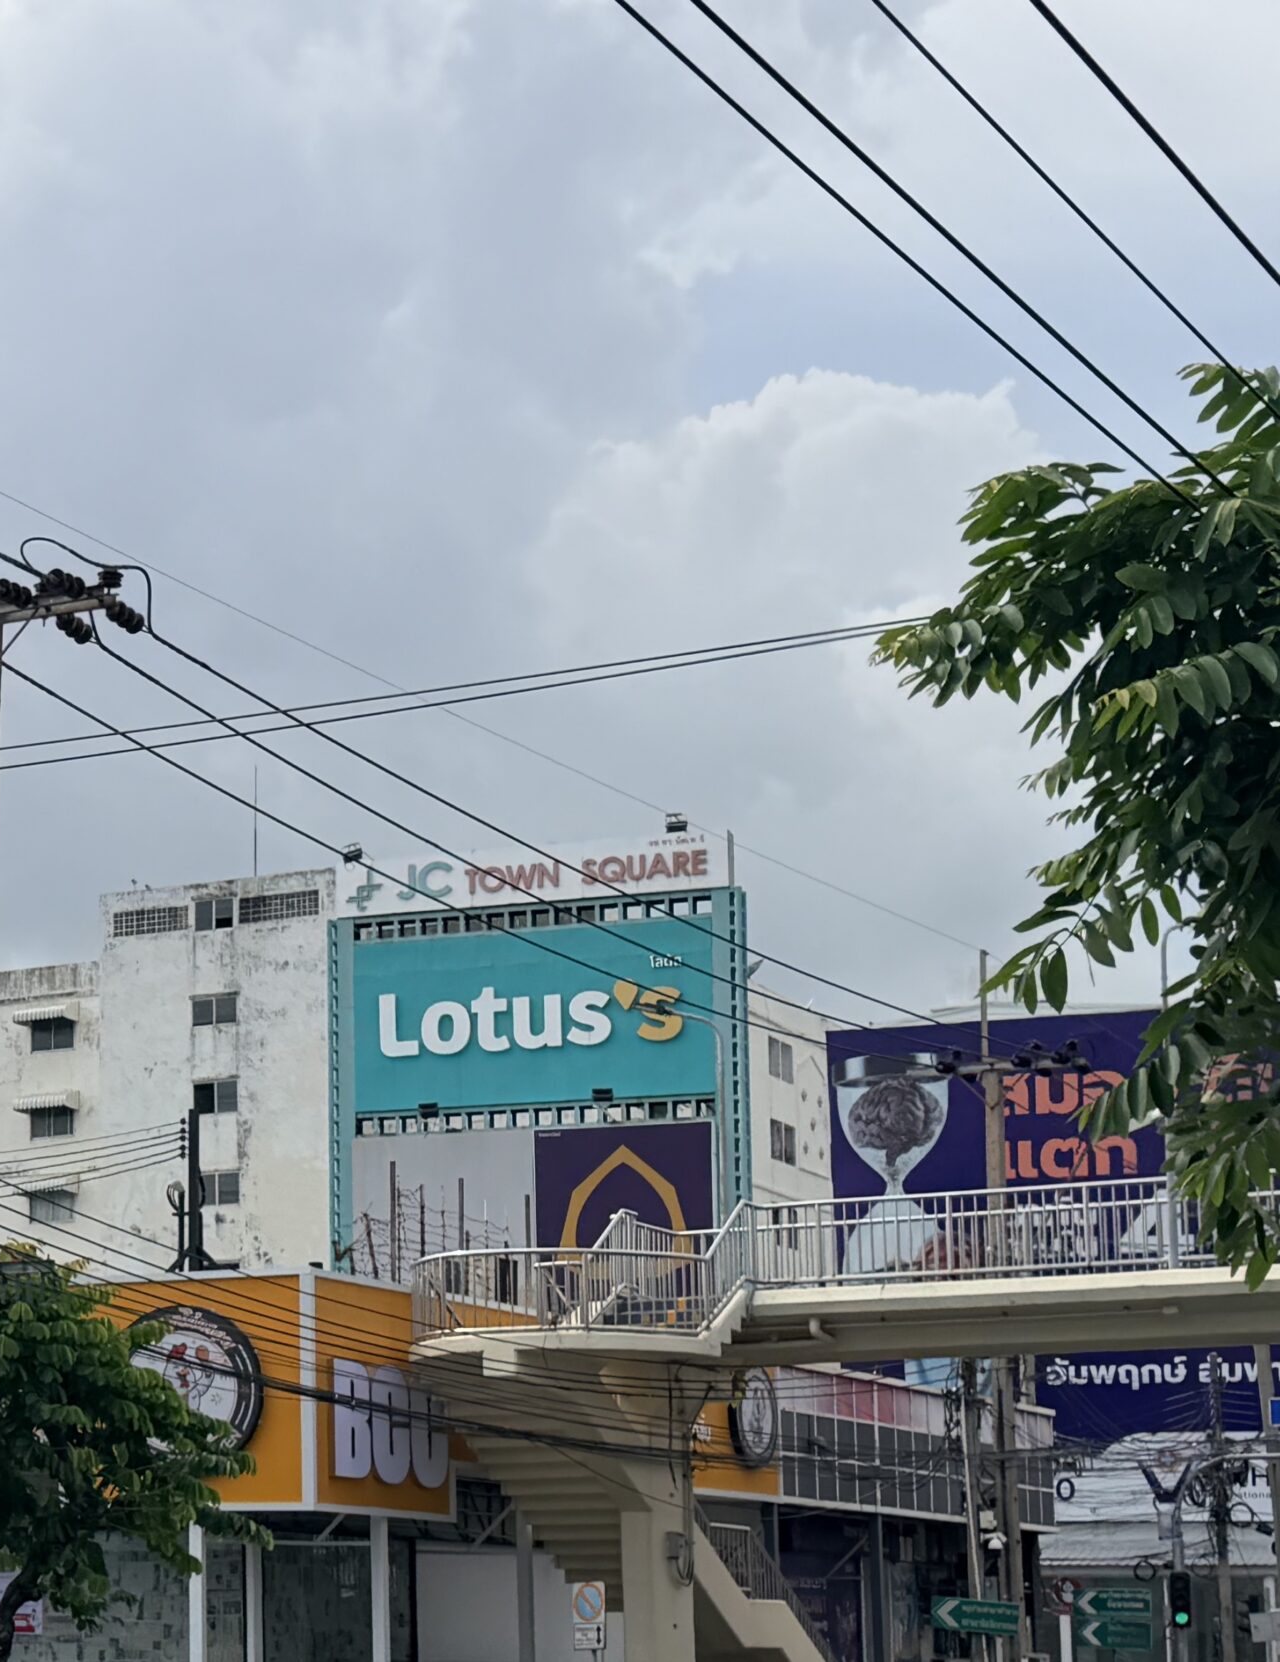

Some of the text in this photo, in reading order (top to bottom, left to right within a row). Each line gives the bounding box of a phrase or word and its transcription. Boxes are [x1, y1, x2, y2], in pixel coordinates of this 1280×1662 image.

[396, 849, 708, 900] JC TOWN SQUARE
[378, 978, 684, 1058] Lotus's
